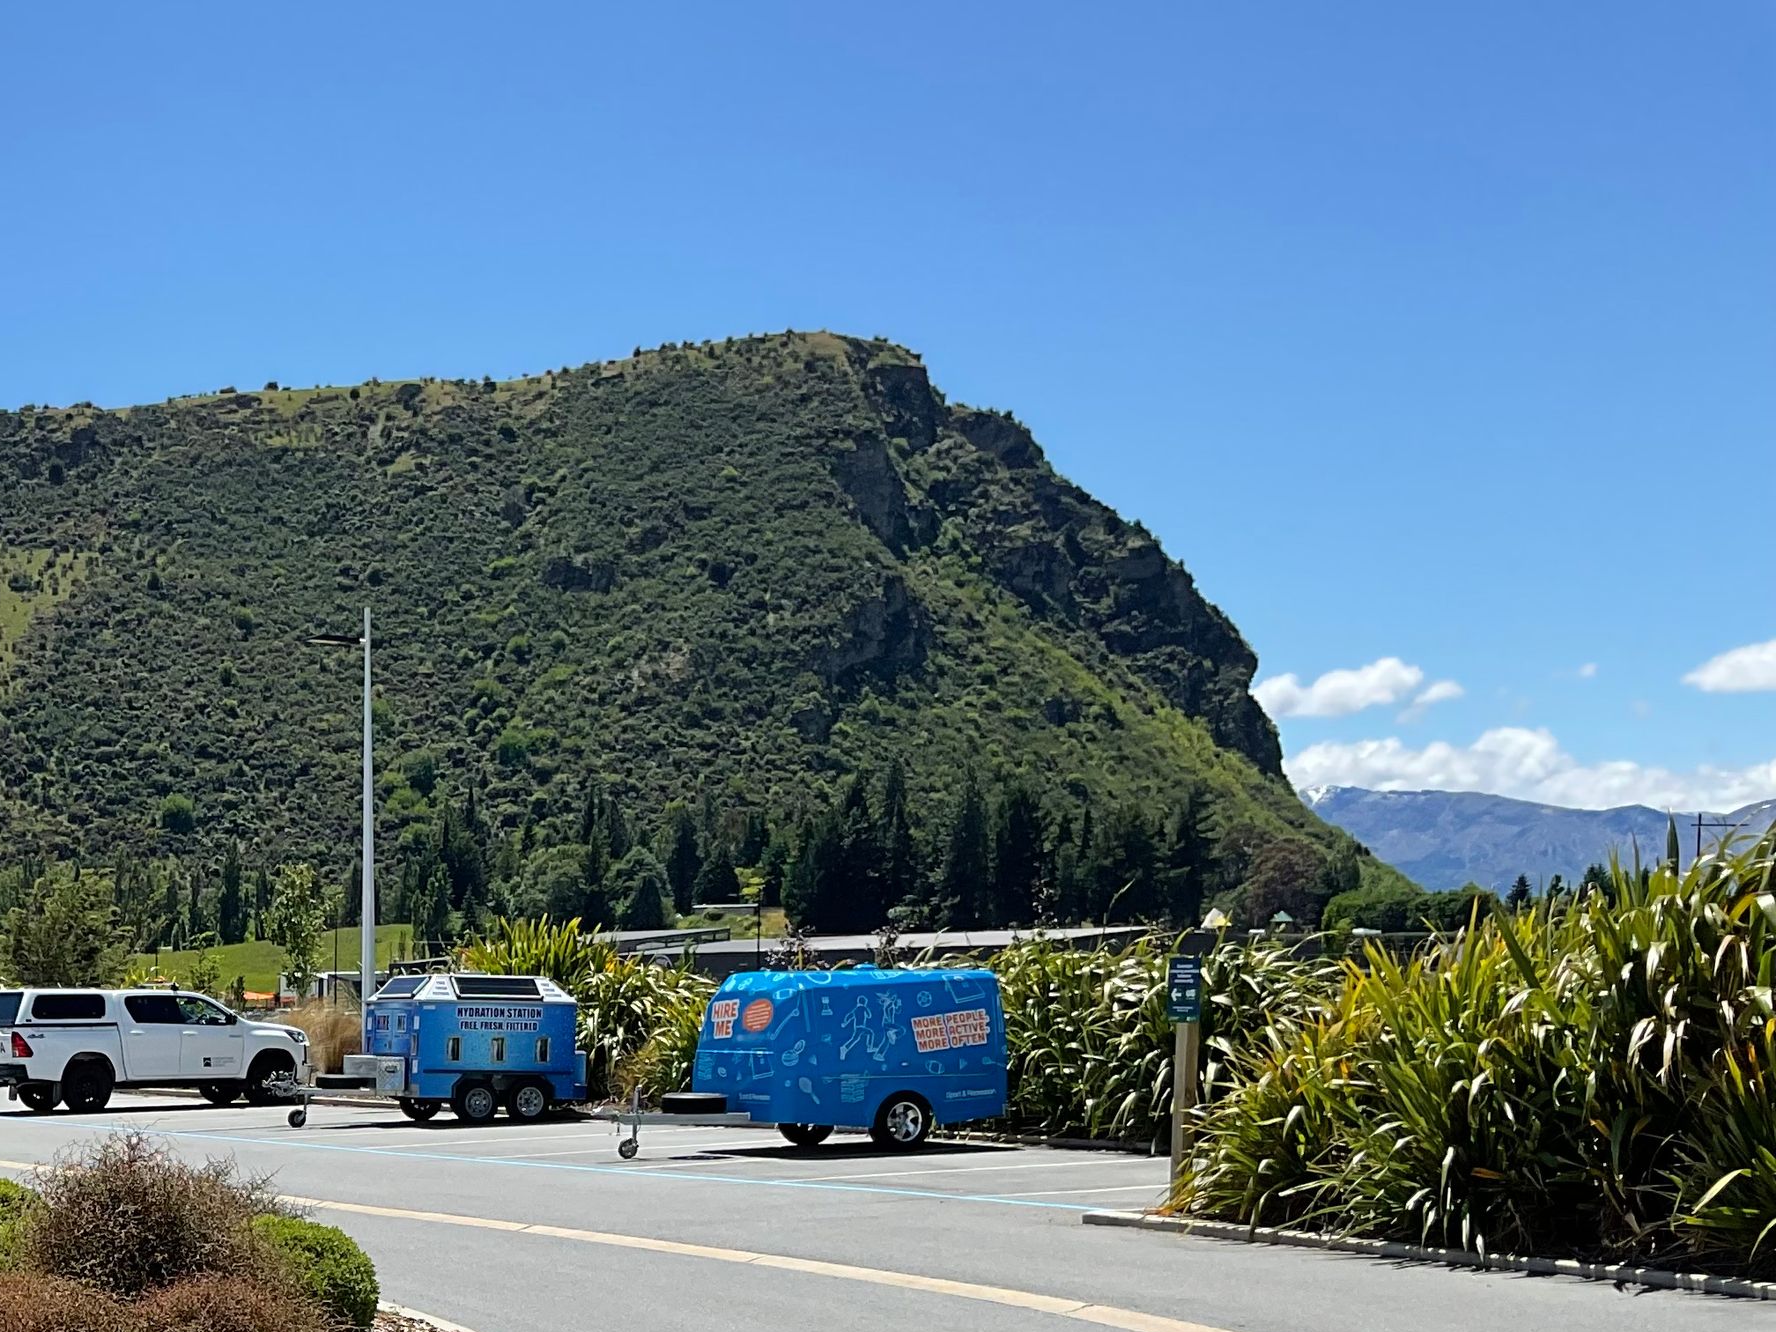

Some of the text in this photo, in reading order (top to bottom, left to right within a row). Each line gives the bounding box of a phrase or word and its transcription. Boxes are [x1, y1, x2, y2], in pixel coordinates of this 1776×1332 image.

[457, 1007, 542, 1019] HYDRATION STATION
[713, 1002, 738, 1019] HIRE
[715, 1021, 732, 1036] ME
[913, 1016, 943, 1028] MORE
[916, 1027, 945, 1039] MORE
[919, 1034, 985, 1051] MORE OFTEN
